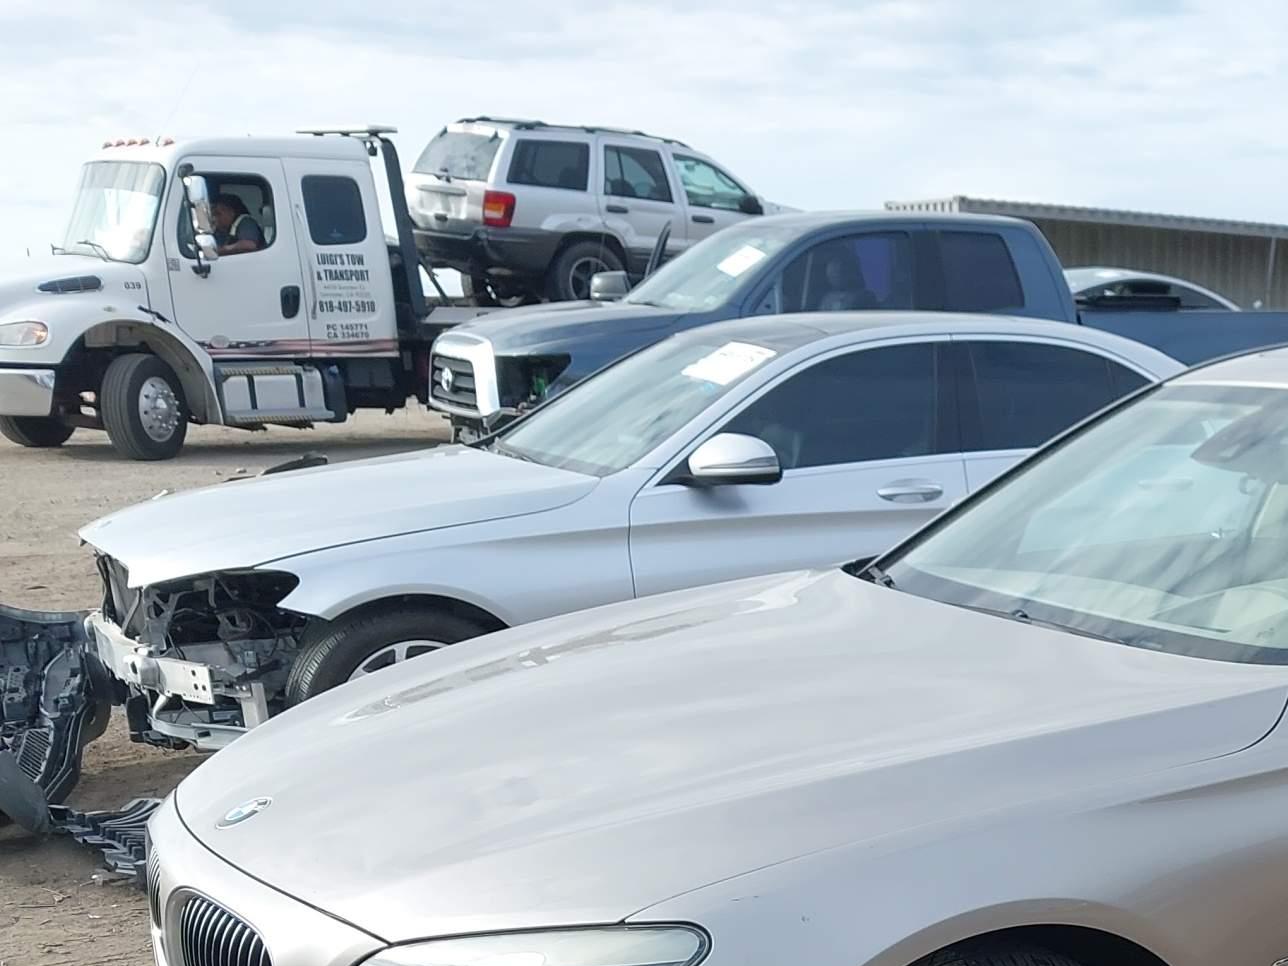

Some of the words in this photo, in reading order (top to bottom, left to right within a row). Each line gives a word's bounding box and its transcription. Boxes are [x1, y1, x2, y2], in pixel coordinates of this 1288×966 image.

[316, 253, 345, 265] LUIGI'S
[346, 254, 364, 265] TOW
[324, 269, 369, 281] TRANSPORT
